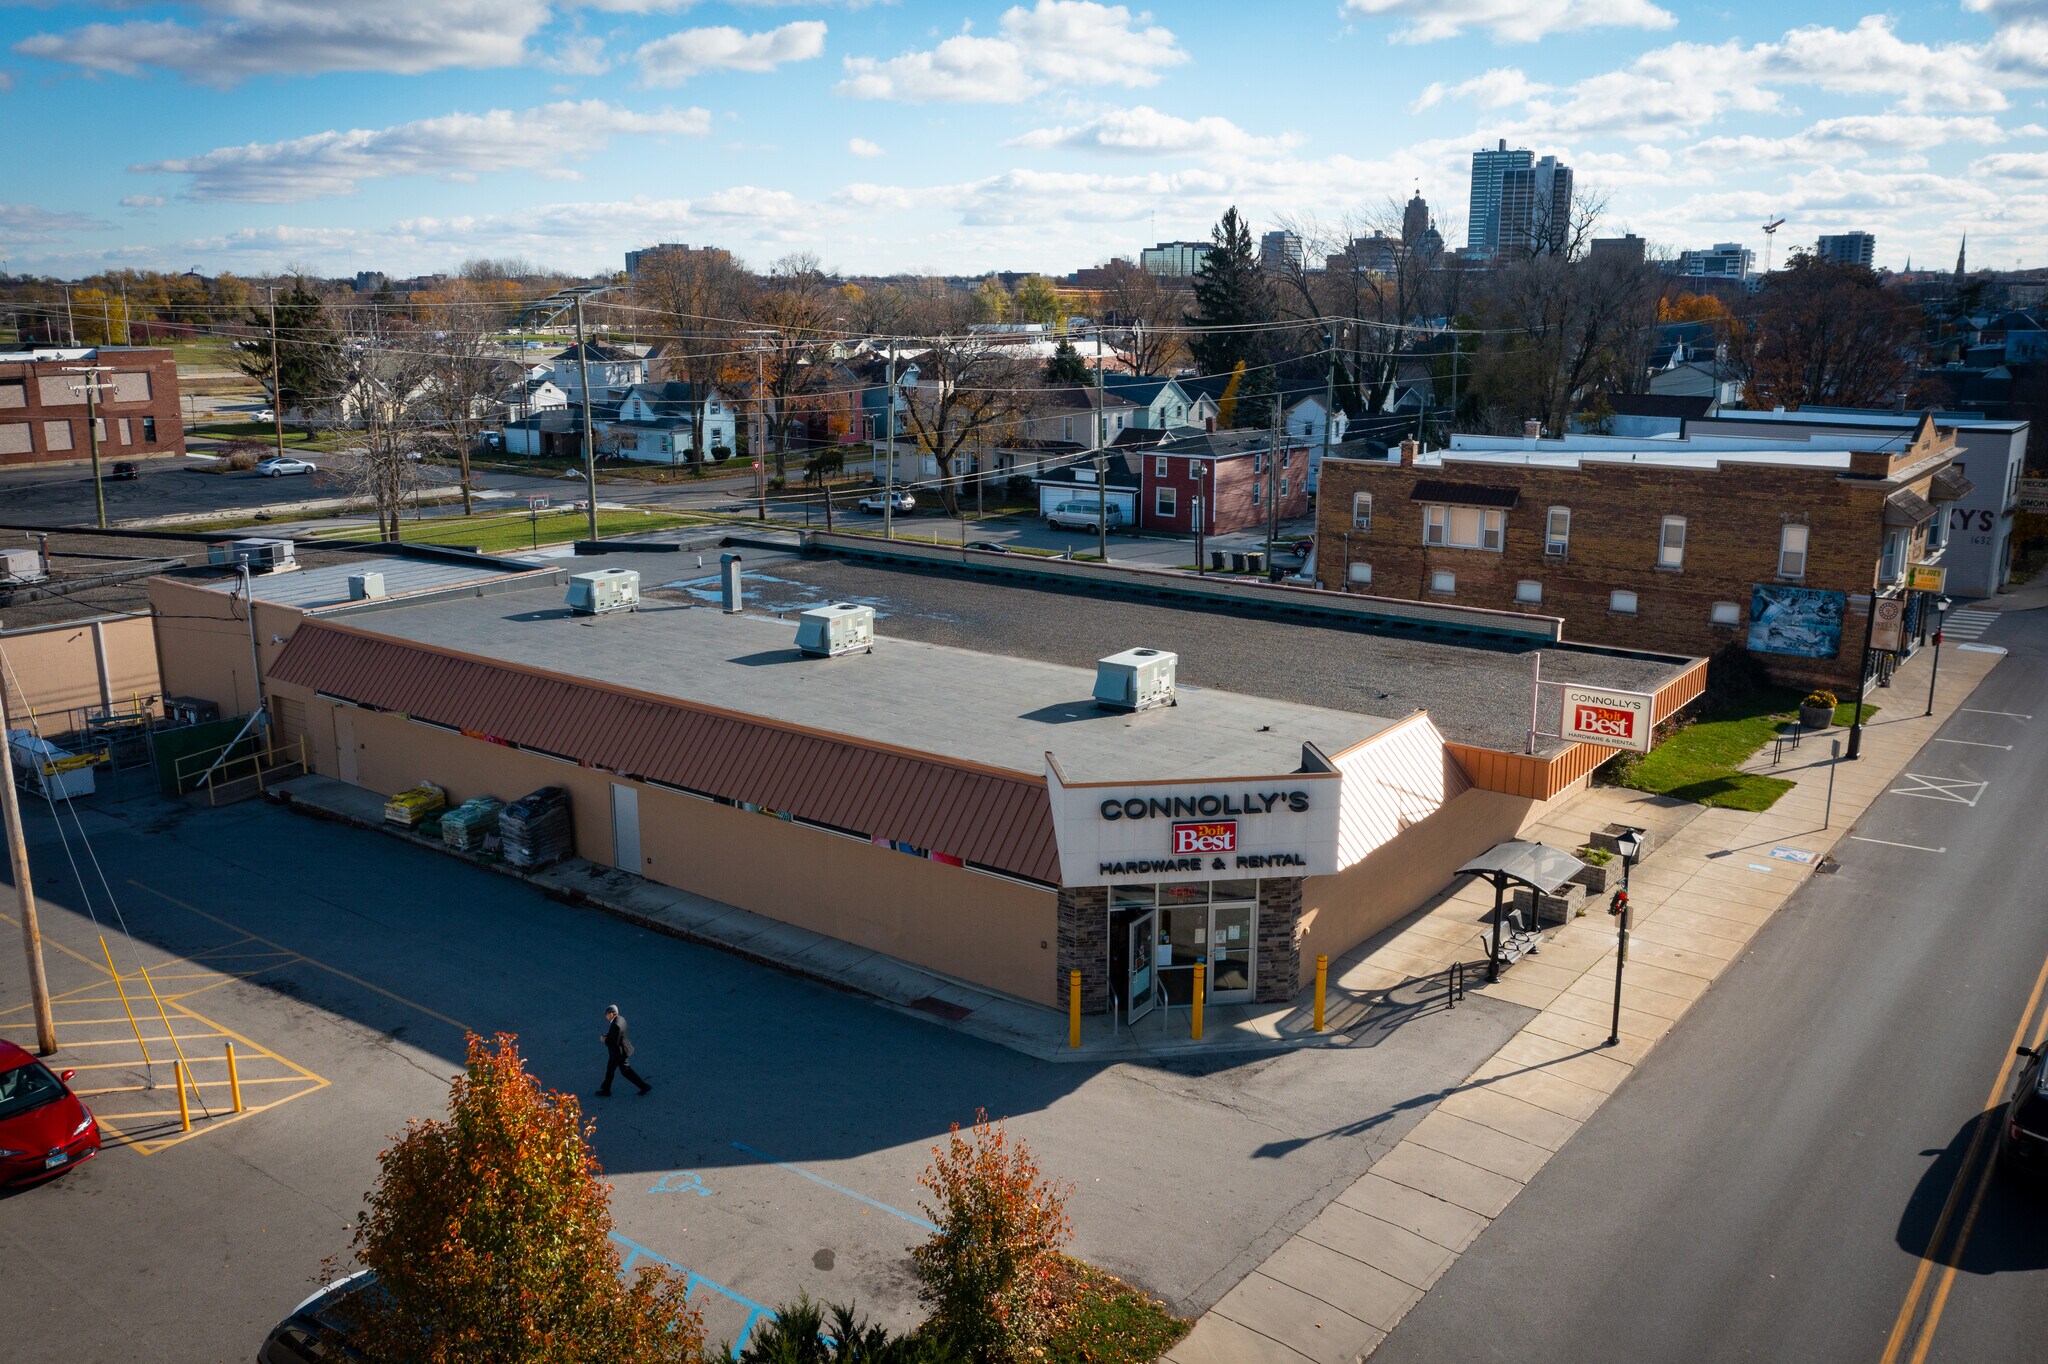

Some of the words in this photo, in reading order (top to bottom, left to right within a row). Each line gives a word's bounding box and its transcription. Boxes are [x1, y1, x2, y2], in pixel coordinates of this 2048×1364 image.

[1970, 536, 1992, 545] 1632
[1571, 693, 1641, 710] CONNOLLY'S
[1579, 709, 1629, 736] Best
[1597, 709, 1613, 720] Do
[1613, 711, 1621, 721] it
[1568, 732, 1604, 742] HARDWARE
[1611, 738, 1637, 747] RENTAL
[1100, 791, 1310, 821] CONNOLLY'S
[1197, 825, 1216, 836] Do
[1216, 825, 1225, 836] it
[1176, 829, 1234, 852] Best
[1100, 858, 1202, 876] HARDWARE
[1212, 858, 1226, 870] &
[1236, 853, 1306, 869] RENTAL
[1167, 886, 1197, 897] OPEN
